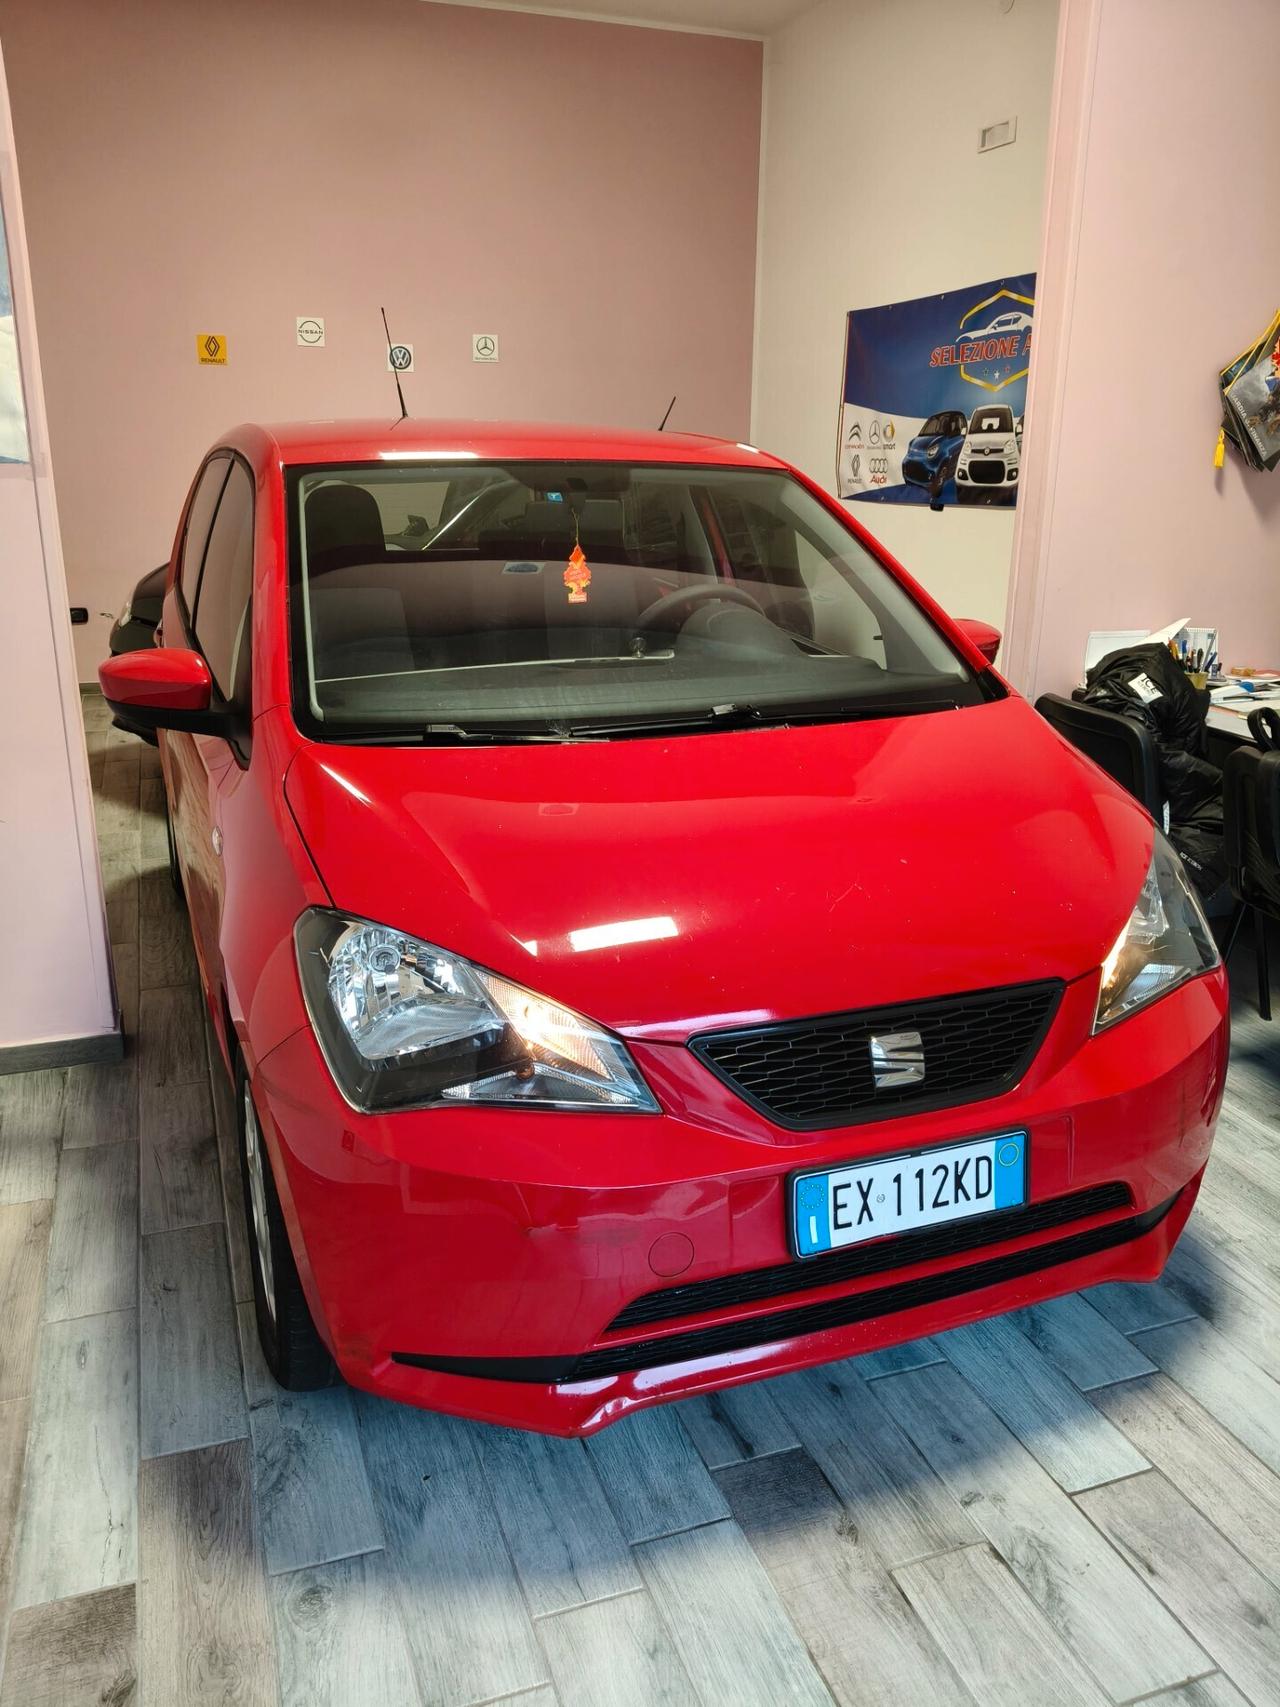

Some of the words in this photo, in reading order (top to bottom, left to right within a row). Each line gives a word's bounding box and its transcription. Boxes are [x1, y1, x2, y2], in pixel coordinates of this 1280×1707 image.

[929, 335, 1020, 368] SELEZIONE
[870, 475, 887, 484] Audi
[833, 1178, 874, 1230] EX
[893, 1155, 992, 1217] 112KD
